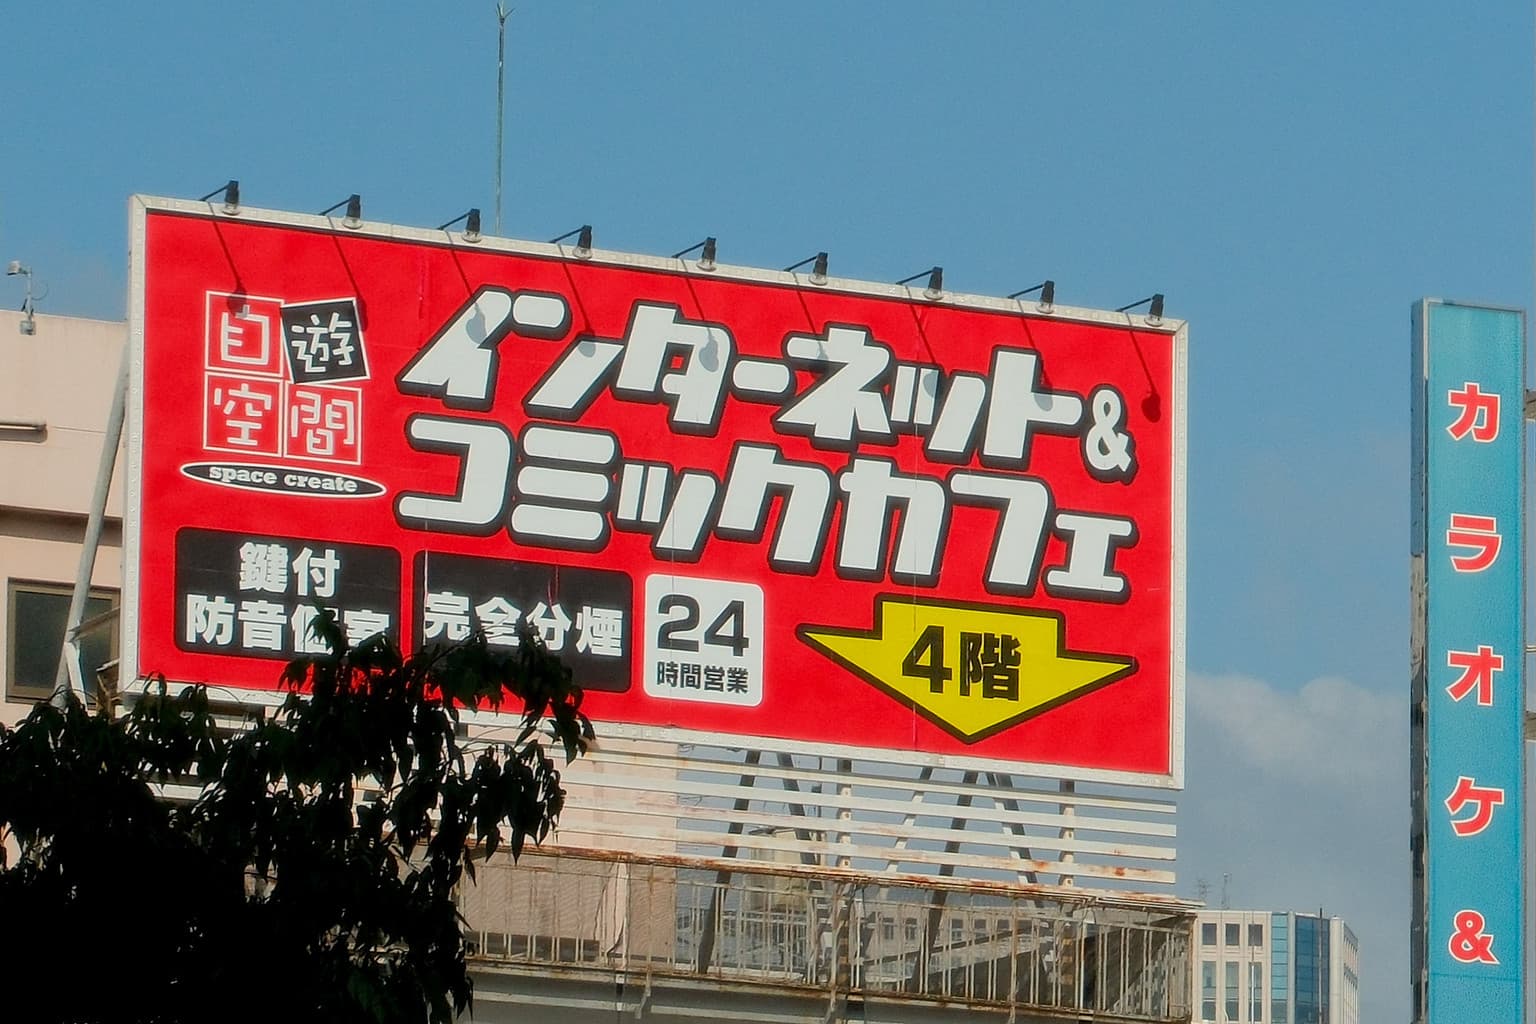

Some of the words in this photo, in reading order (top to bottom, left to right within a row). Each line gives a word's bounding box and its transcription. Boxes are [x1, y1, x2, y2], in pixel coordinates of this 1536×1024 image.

[209, 466, 278, 483] space
[283, 473, 358, 493] create
[396, 413, 1138, 603] コミックカフェ
[239, 541, 341, 598] 鍵付
[425, 591, 624, 657] 完全分煙
[657, 593, 750, 657] 24
[656, 660, 750, 694] 時間営業
[901, 624, 1022, 703] 4階
